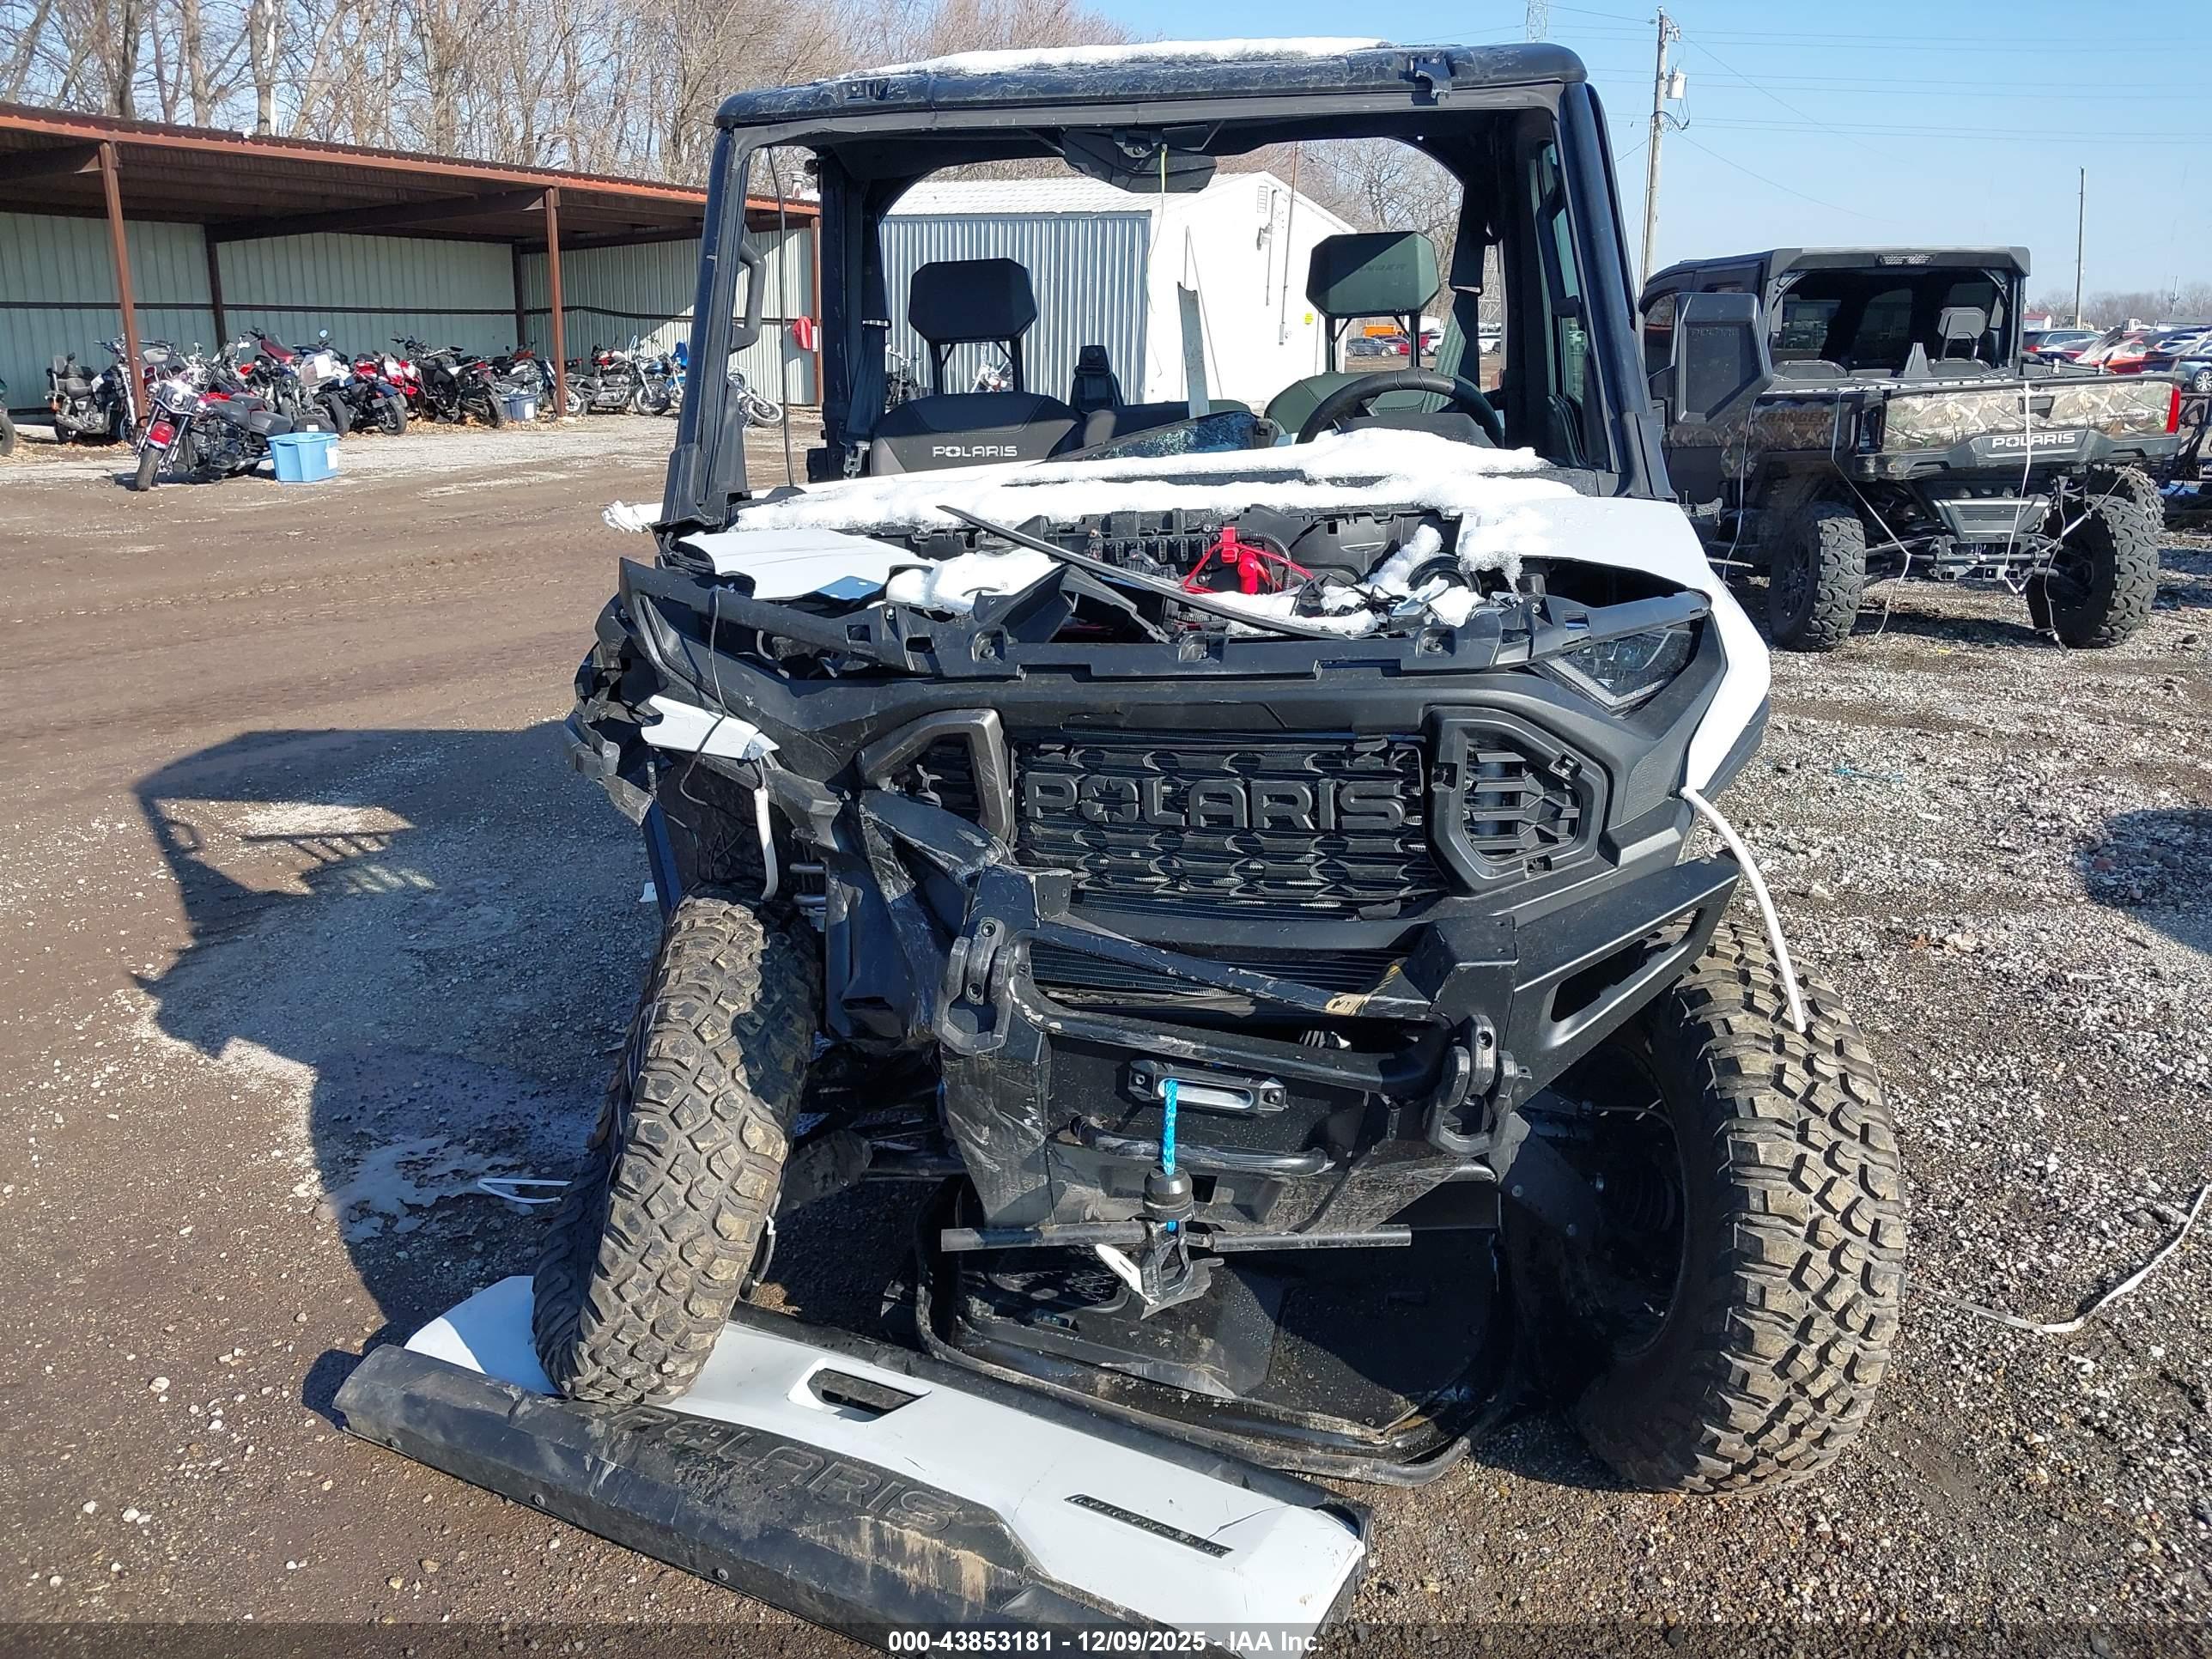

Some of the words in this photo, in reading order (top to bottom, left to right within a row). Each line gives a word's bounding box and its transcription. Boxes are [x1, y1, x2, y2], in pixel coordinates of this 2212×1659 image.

[1765, 411, 1831, 422] RANGER
[1991, 432, 2075, 448] POLARIS
[932, 446, 1018, 458] POLARIS
[1025, 773, 1407, 830] POLARIS
[600, 1405, 963, 1532] POLARIS
